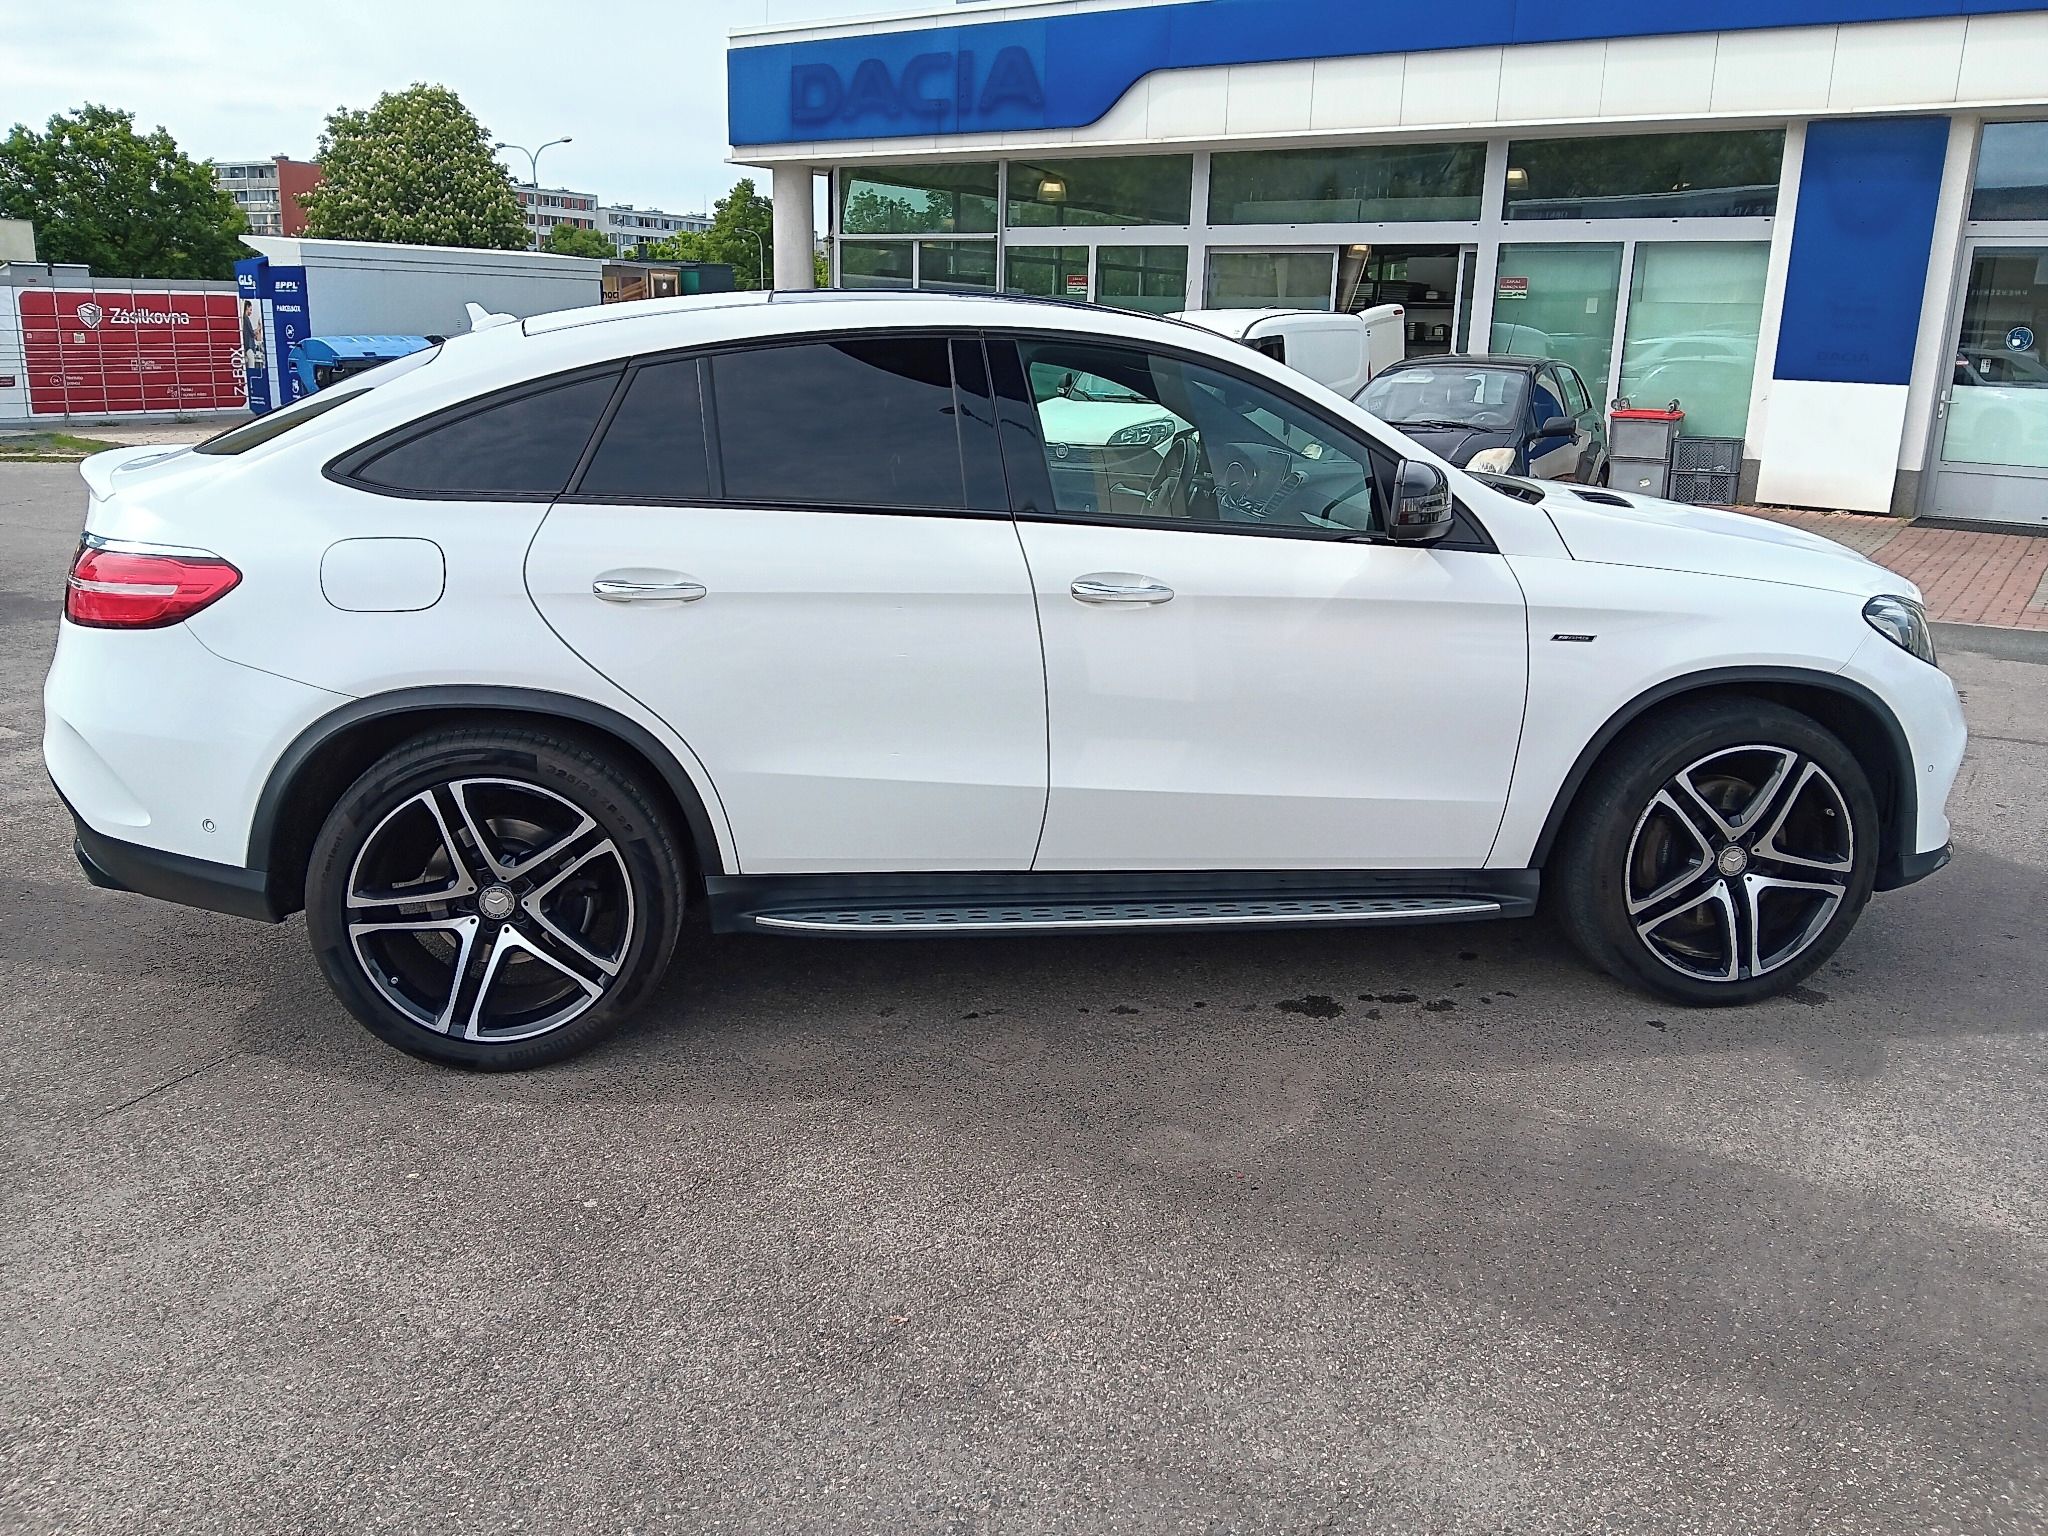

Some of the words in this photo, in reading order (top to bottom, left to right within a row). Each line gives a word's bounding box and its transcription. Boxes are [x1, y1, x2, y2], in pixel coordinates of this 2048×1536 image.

[791, 46, 1044, 124] DACIA
[238, 274, 253, 286] GLS
[109, 307, 190, 325] Zásilkovna
[230, 347, 246, 396] Z-BOX
